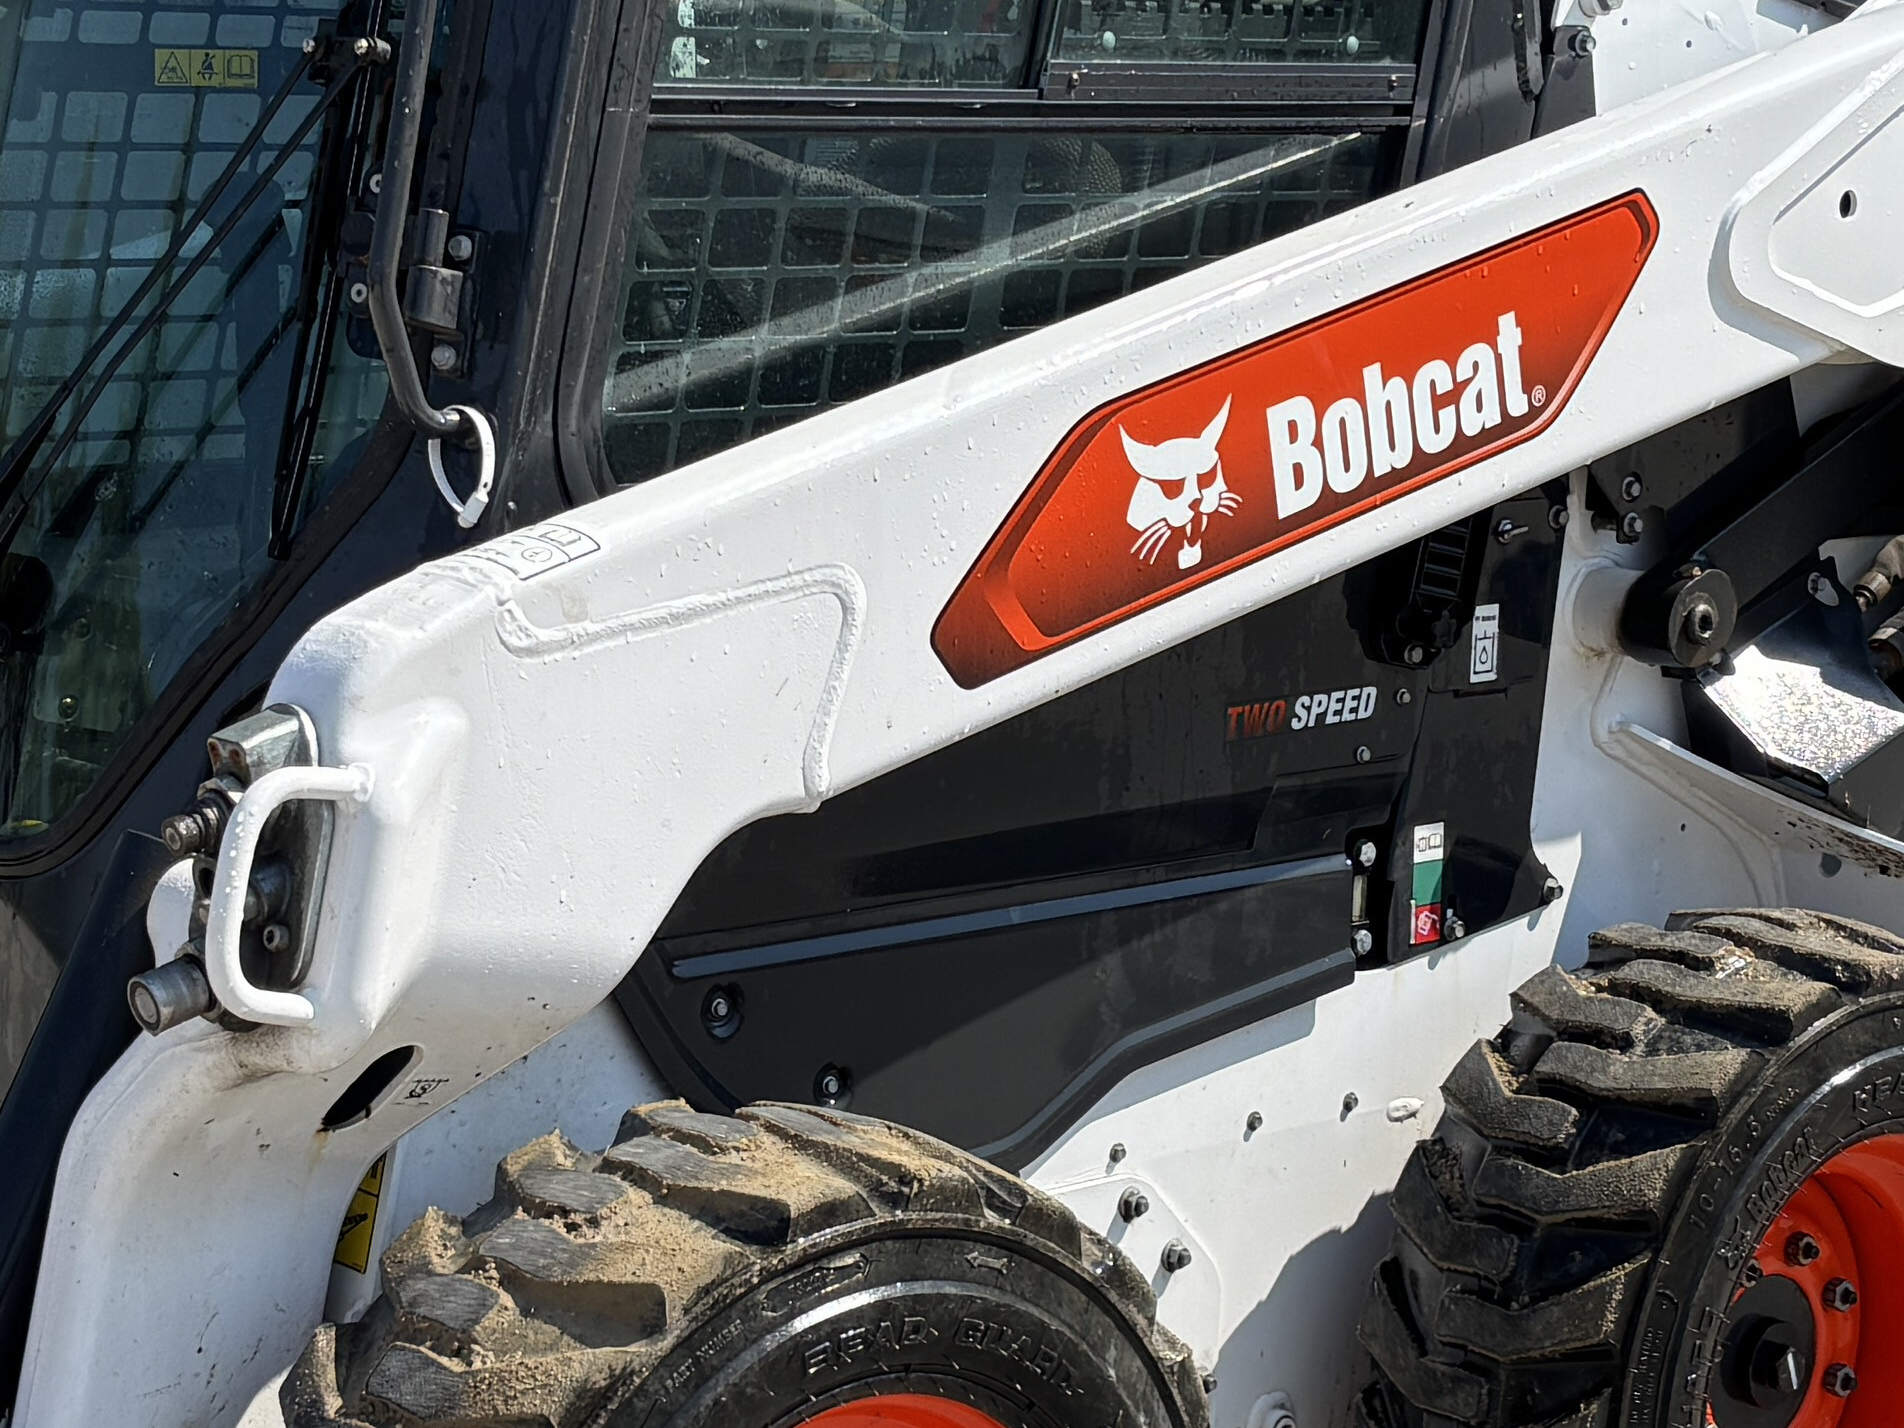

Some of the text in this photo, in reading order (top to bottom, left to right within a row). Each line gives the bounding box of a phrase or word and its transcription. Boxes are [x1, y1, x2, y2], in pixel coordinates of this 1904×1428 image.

[1266, 310, 1529, 520] Bobcat
[1226, 685, 1378, 742] TWO SPEED
